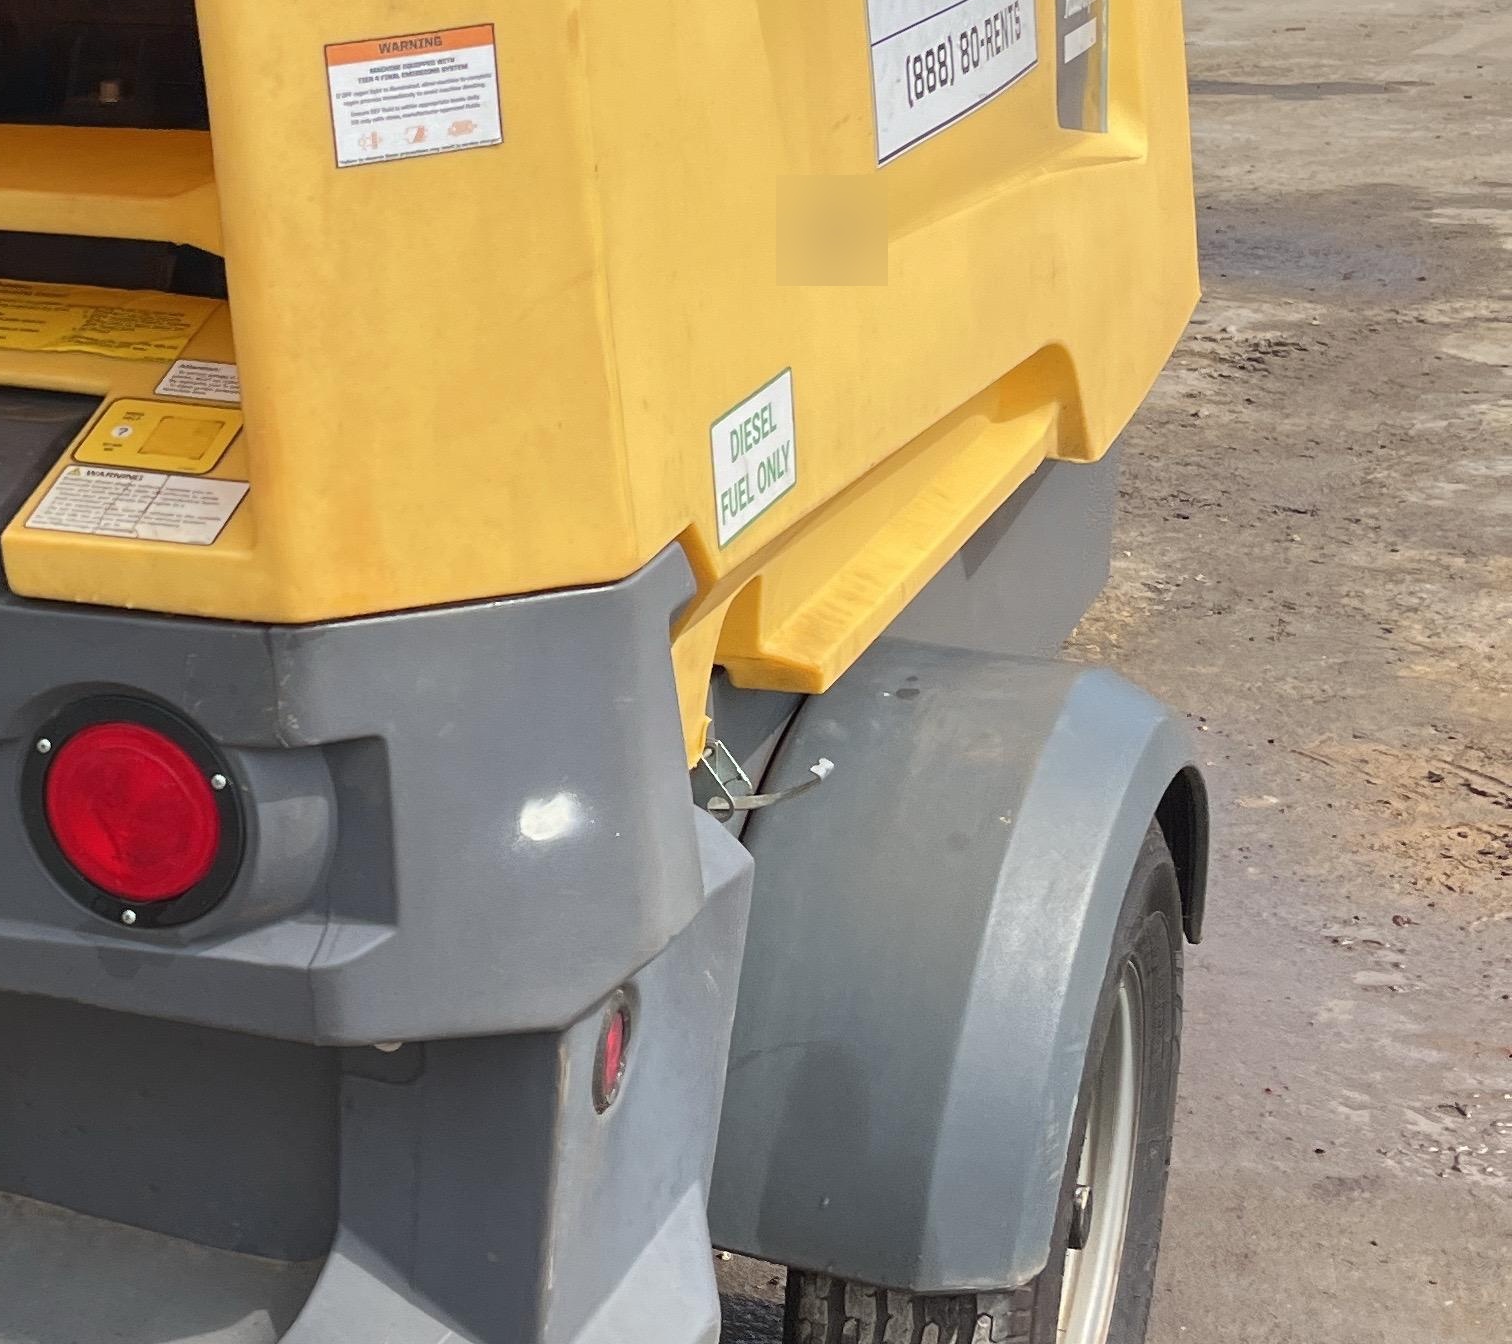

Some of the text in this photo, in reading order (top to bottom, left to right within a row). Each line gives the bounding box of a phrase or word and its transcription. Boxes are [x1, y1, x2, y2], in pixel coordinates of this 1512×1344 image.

[378, 36, 443, 54] WARNING
[906, 0, 1022, 108] (888) 80-RENTS
[729, 402, 777, 464] DIESEL
[720, 440, 790, 526] FUEL ONLY
